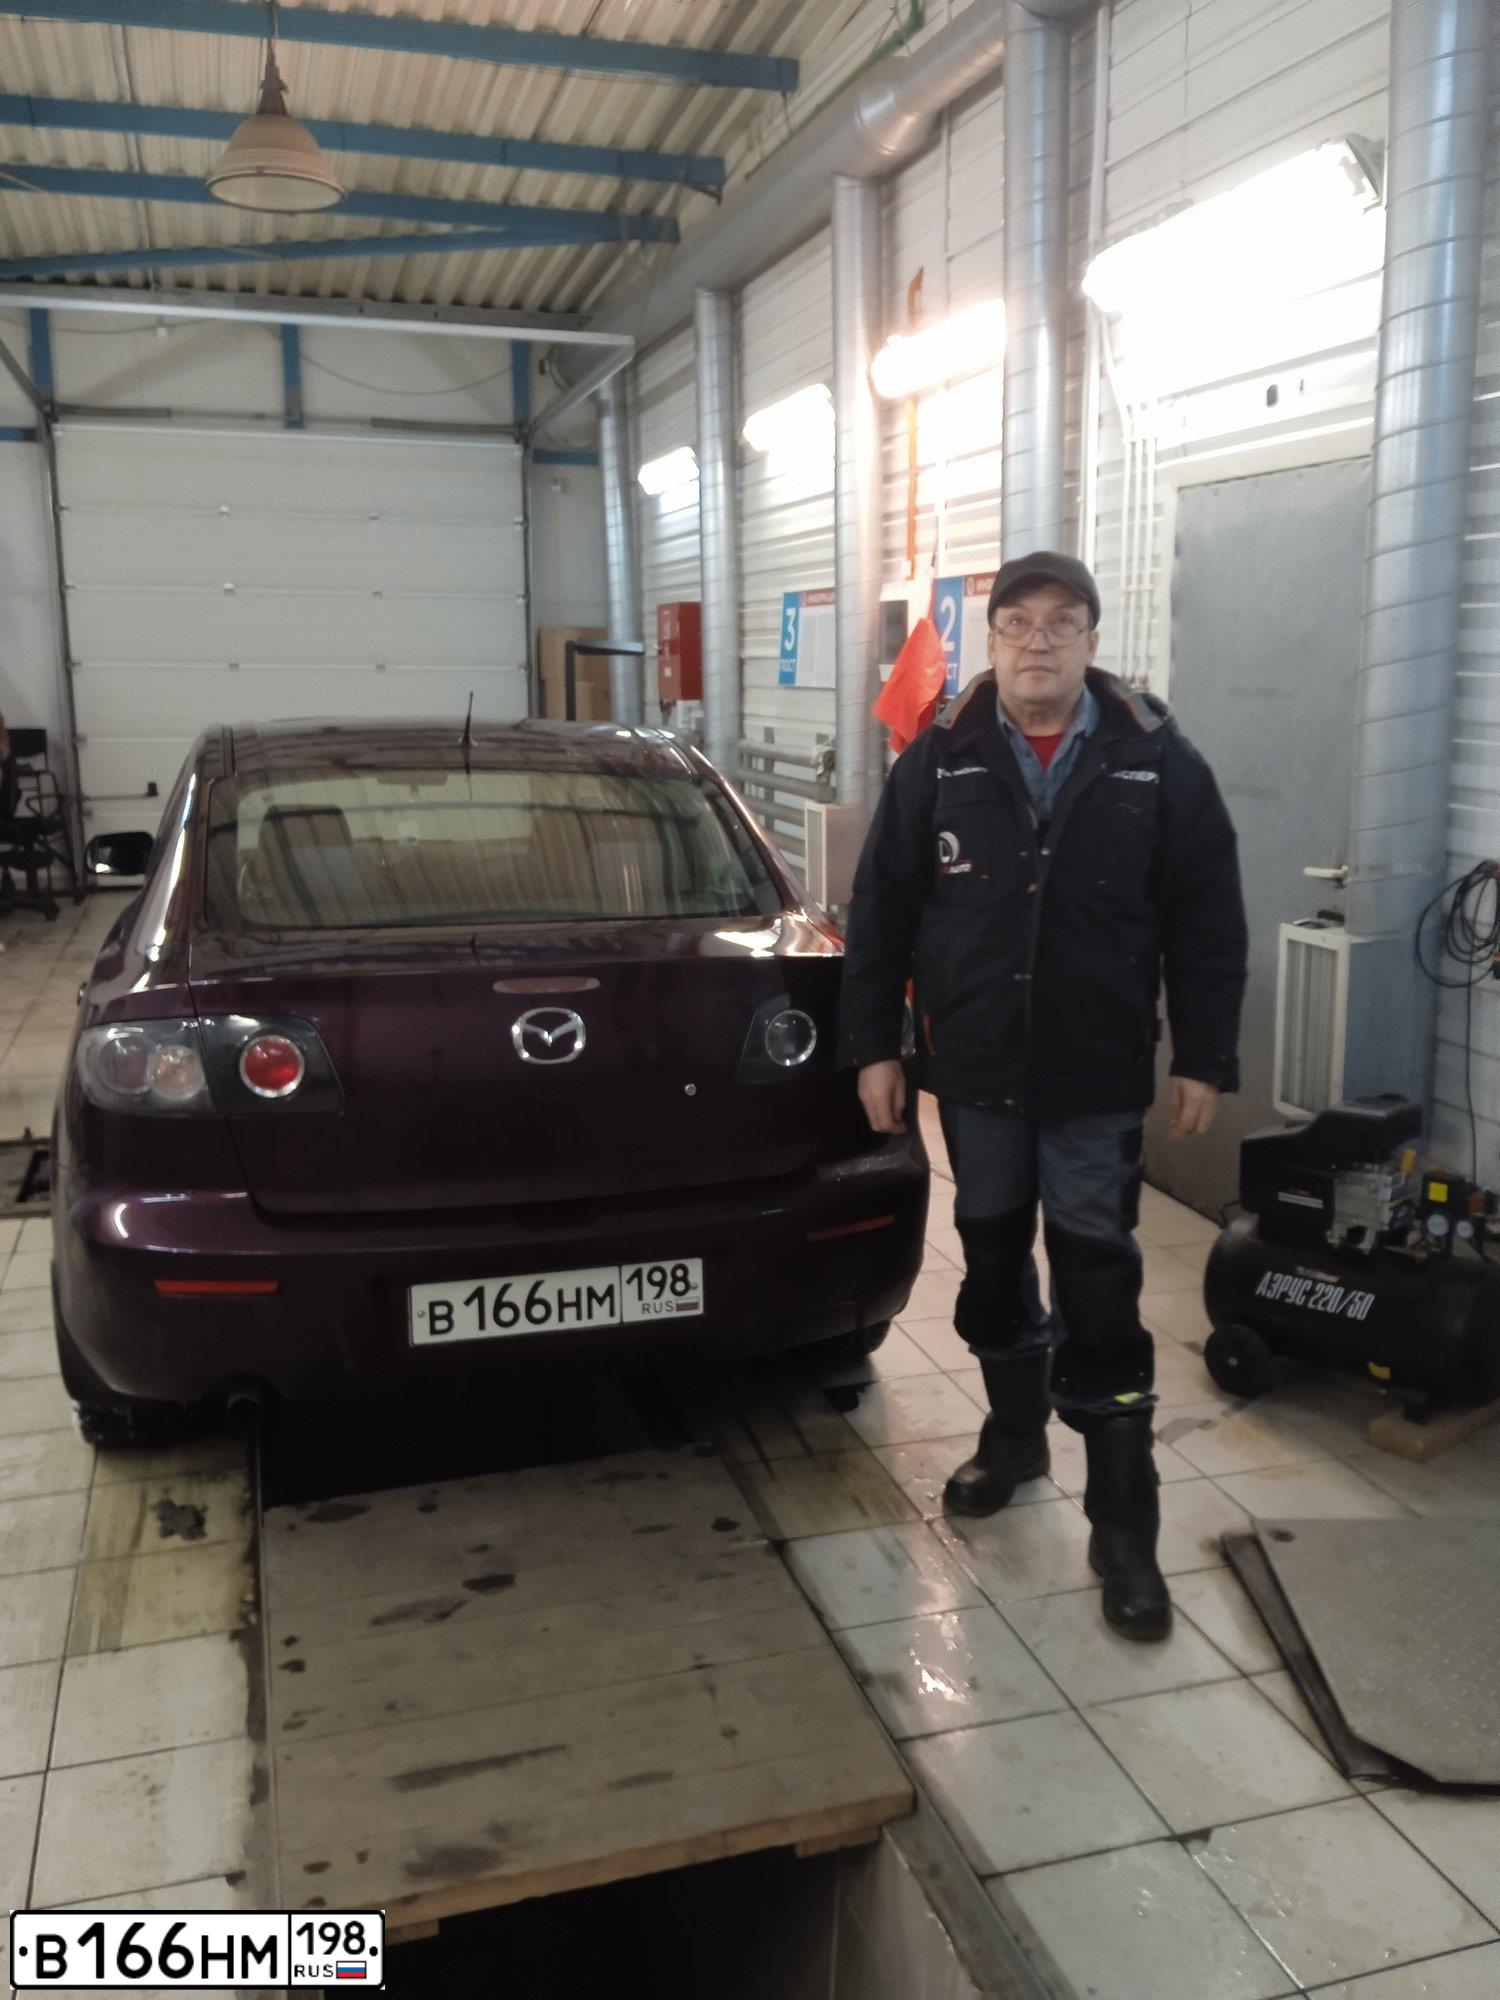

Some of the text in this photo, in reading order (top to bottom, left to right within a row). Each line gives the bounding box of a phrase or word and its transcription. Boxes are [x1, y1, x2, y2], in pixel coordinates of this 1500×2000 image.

[784, 607, 797, 651] 3
[941, 596, 956, 652] 2
[626, 1263, 691, 1301] 198
[1256, 1270, 1313, 1306] АЭРУС
[1307, 1281, 1376, 1321] 220/50
[427, 1280, 617, 1336] В166НМ
[641, 1299, 676, 1316] RUS
